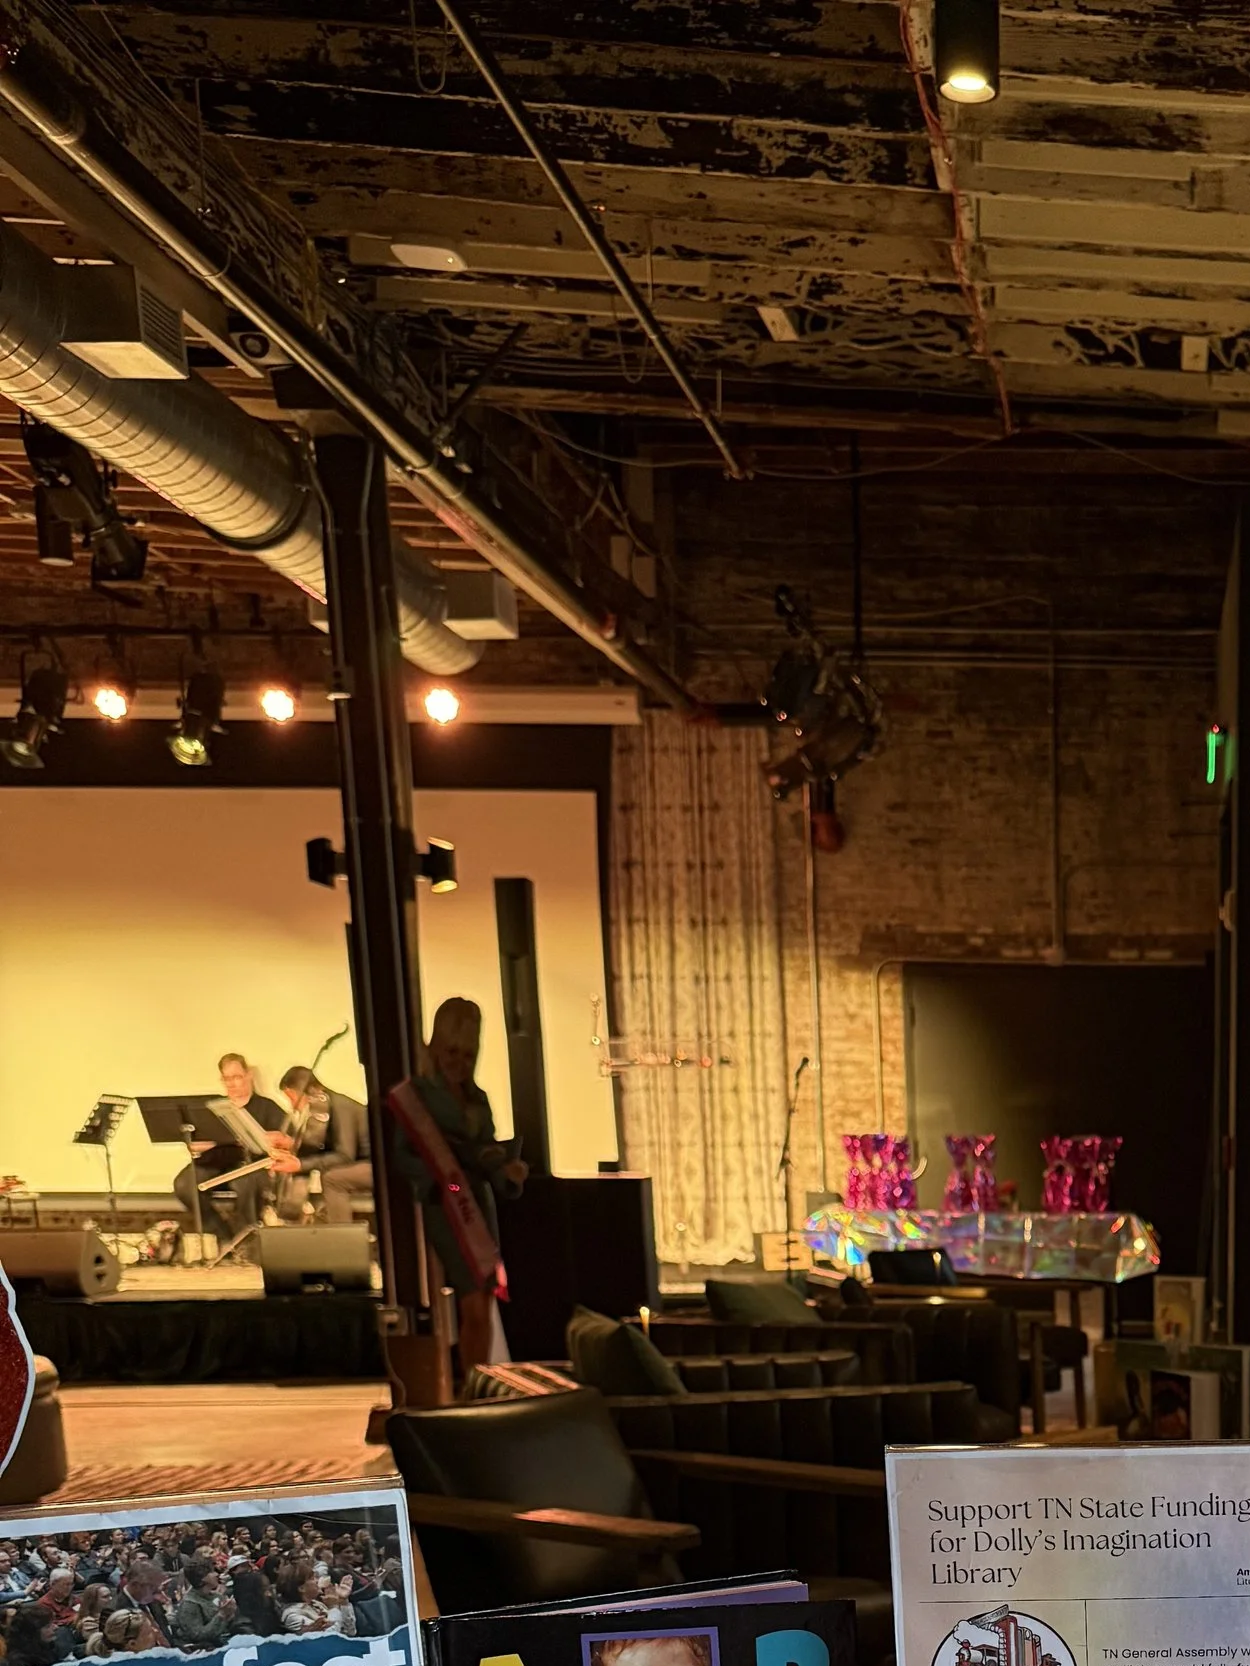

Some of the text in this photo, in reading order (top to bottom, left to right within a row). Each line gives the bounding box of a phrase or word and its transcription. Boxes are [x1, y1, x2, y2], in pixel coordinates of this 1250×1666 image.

[928, 1499, 1032, 1528] Support
[1037, 1497, 1072, 1519] TN
[1079, 1497, 1144, 1519] State
[930, 1529, 966, 1553] for
[1063, 1528, 1211, 1557] Imagination
[932, 1560, 1022, 1587] Library
[1101, 1648, 1118, 1659] TN
[1121, 1647, 1172, 1659] General
[1175, 1645, 1238, 1659] Assembly
